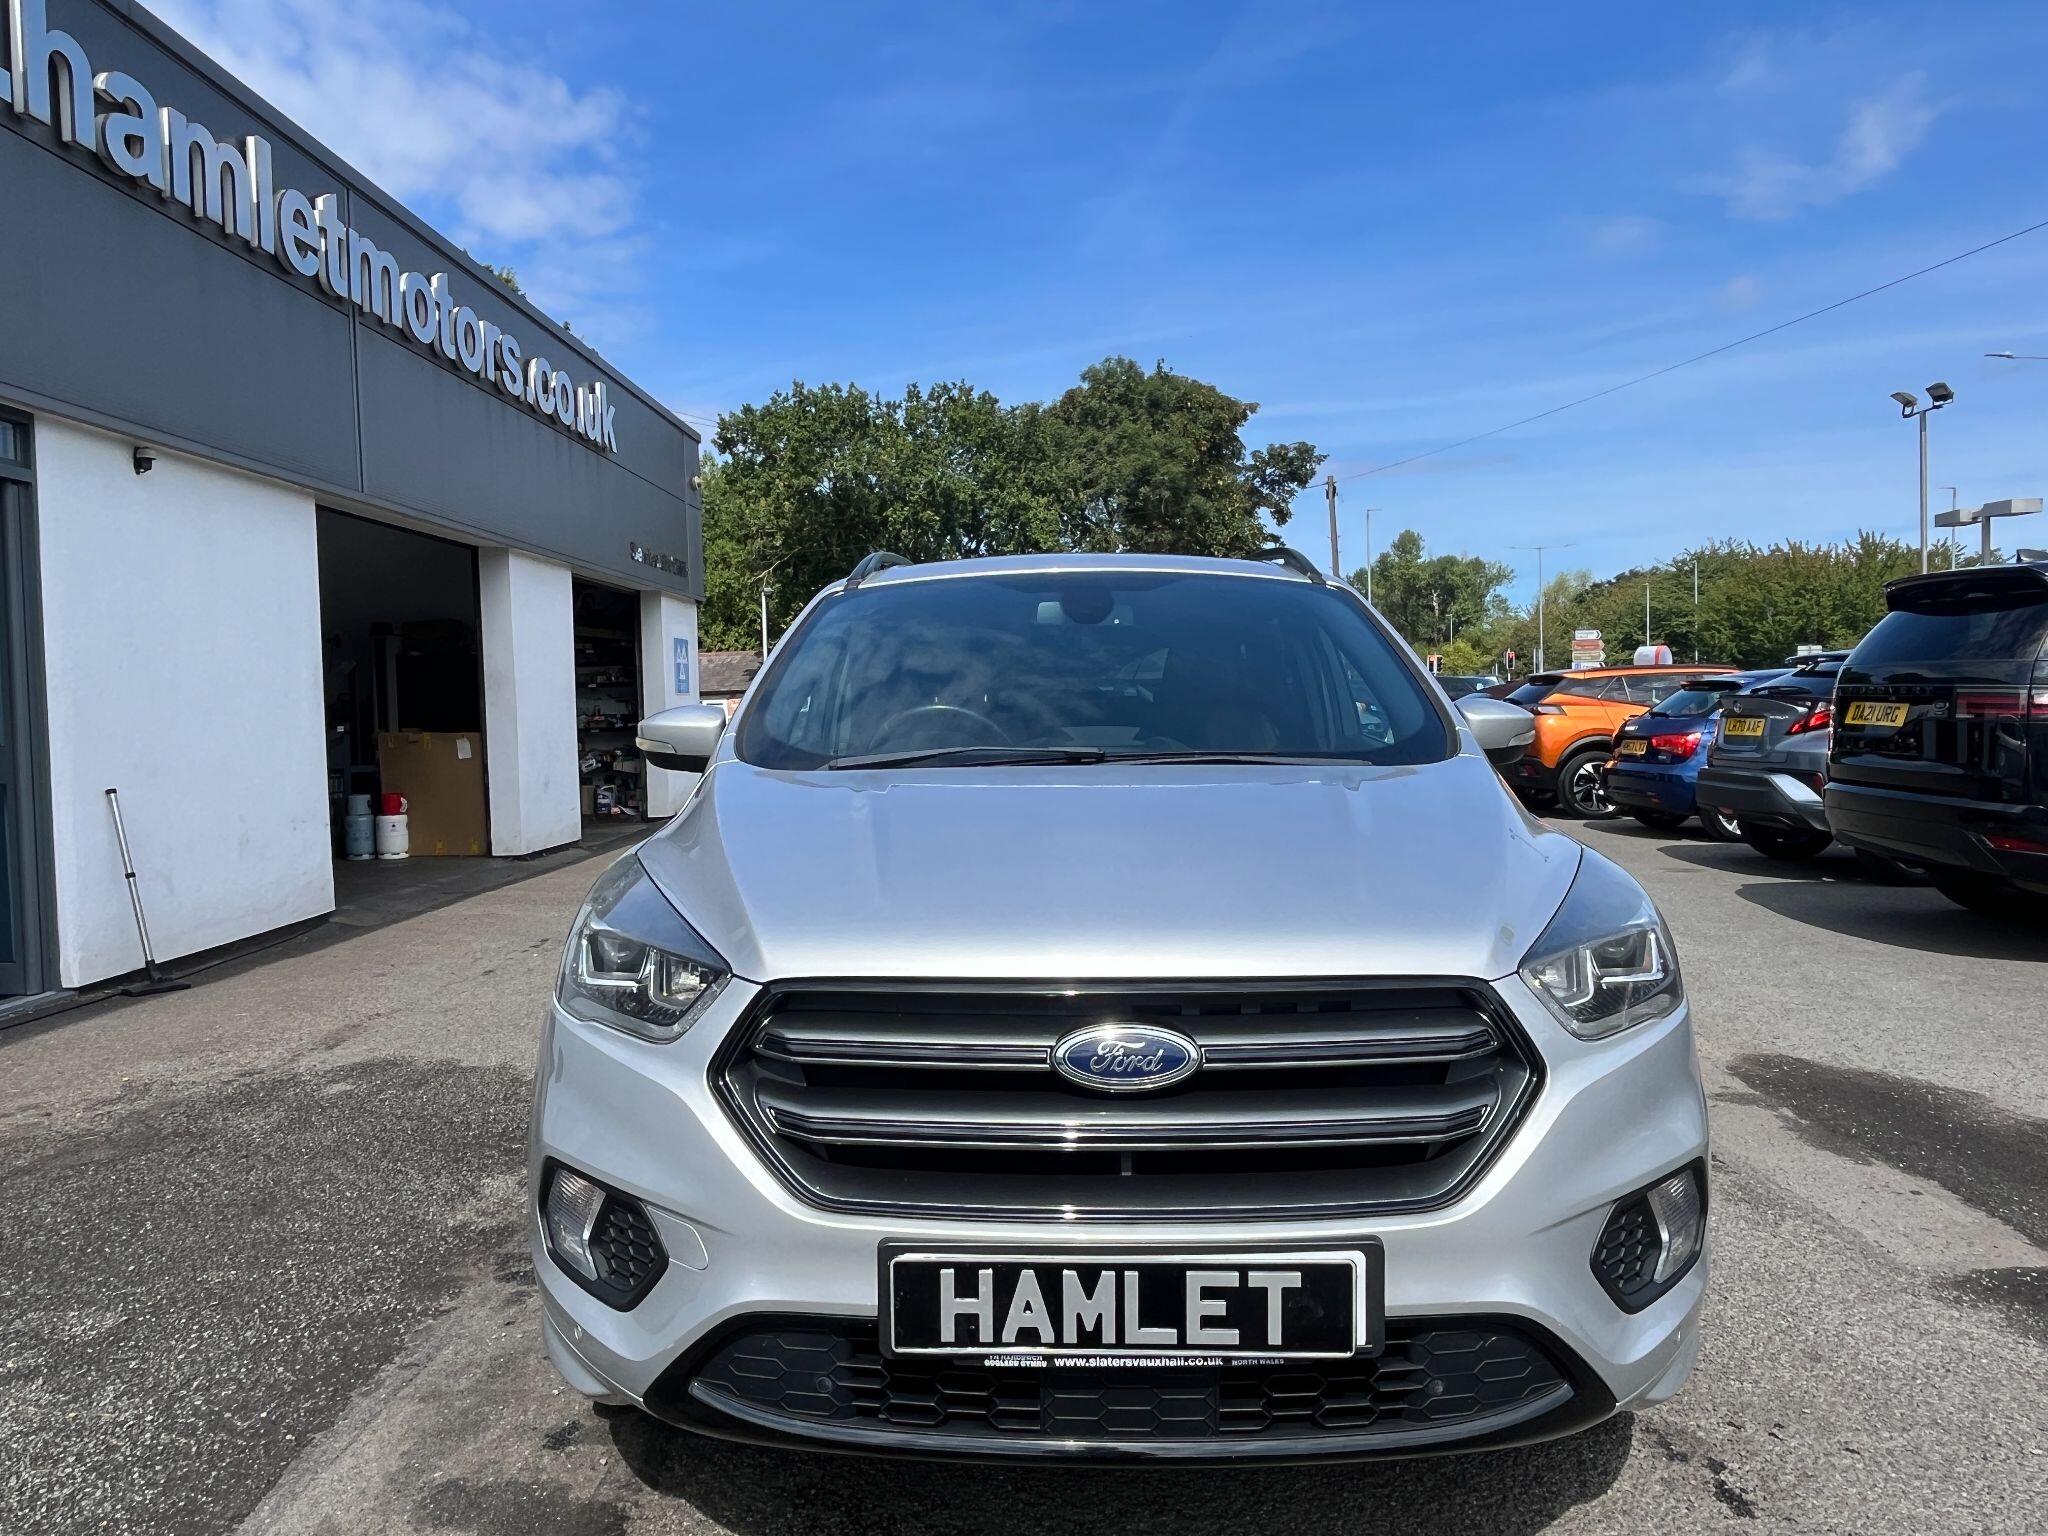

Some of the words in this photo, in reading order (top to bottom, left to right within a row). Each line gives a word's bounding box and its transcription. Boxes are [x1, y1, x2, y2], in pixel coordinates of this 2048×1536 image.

[1852, 704, 1876, 722] DA21
[1090, 1040, 1165, 1073] Ford
[940, 1268, 1302, 1345] HAMLET
[1053, 1356, 1224, 1367] www.slatersvauxhall.co.uk
